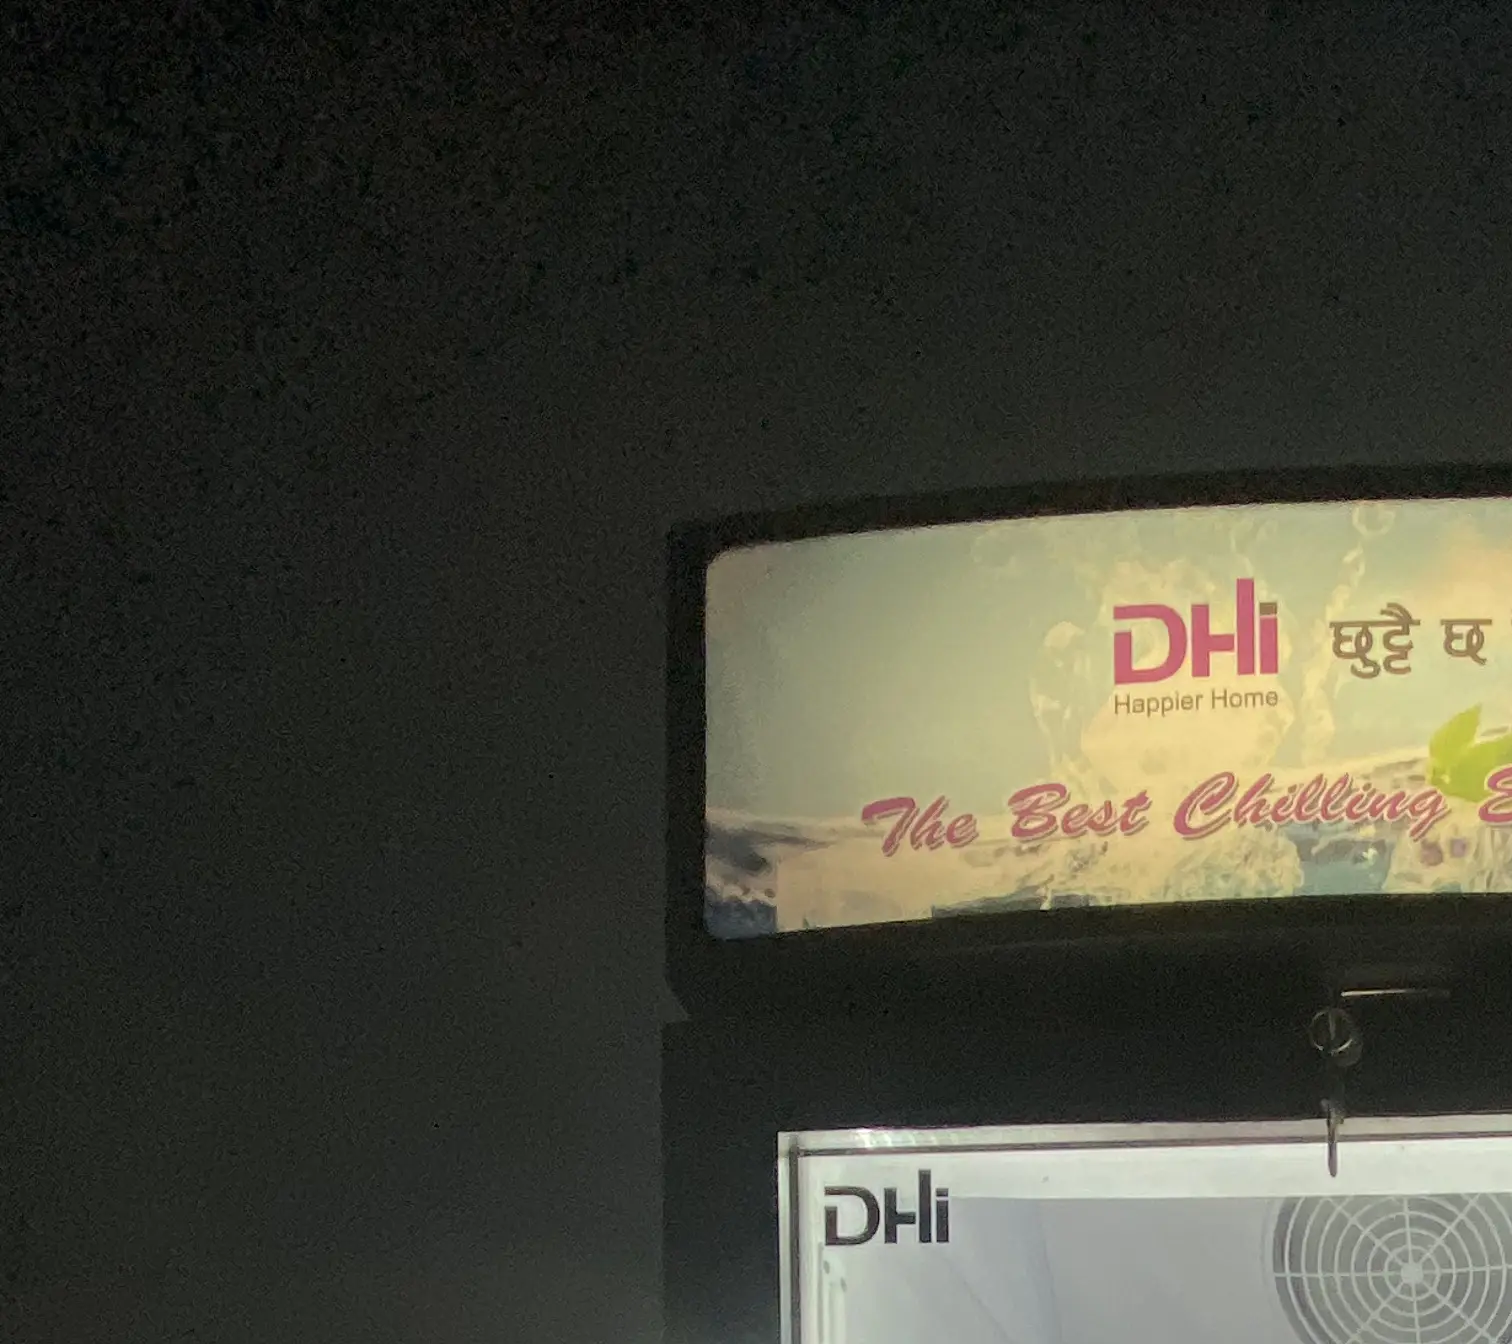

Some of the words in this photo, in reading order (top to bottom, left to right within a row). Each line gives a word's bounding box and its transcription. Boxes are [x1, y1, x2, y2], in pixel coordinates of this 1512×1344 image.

[1440, 618, 1493, 666] छ
[1114, 693, 1204, 718] Happier
[1211, 688, 1279, 711] Home
[861, 794, 980, 857] The
[1008, 782, 1153, 842] Best
[1174, 771, 1452, 842] Chilling
